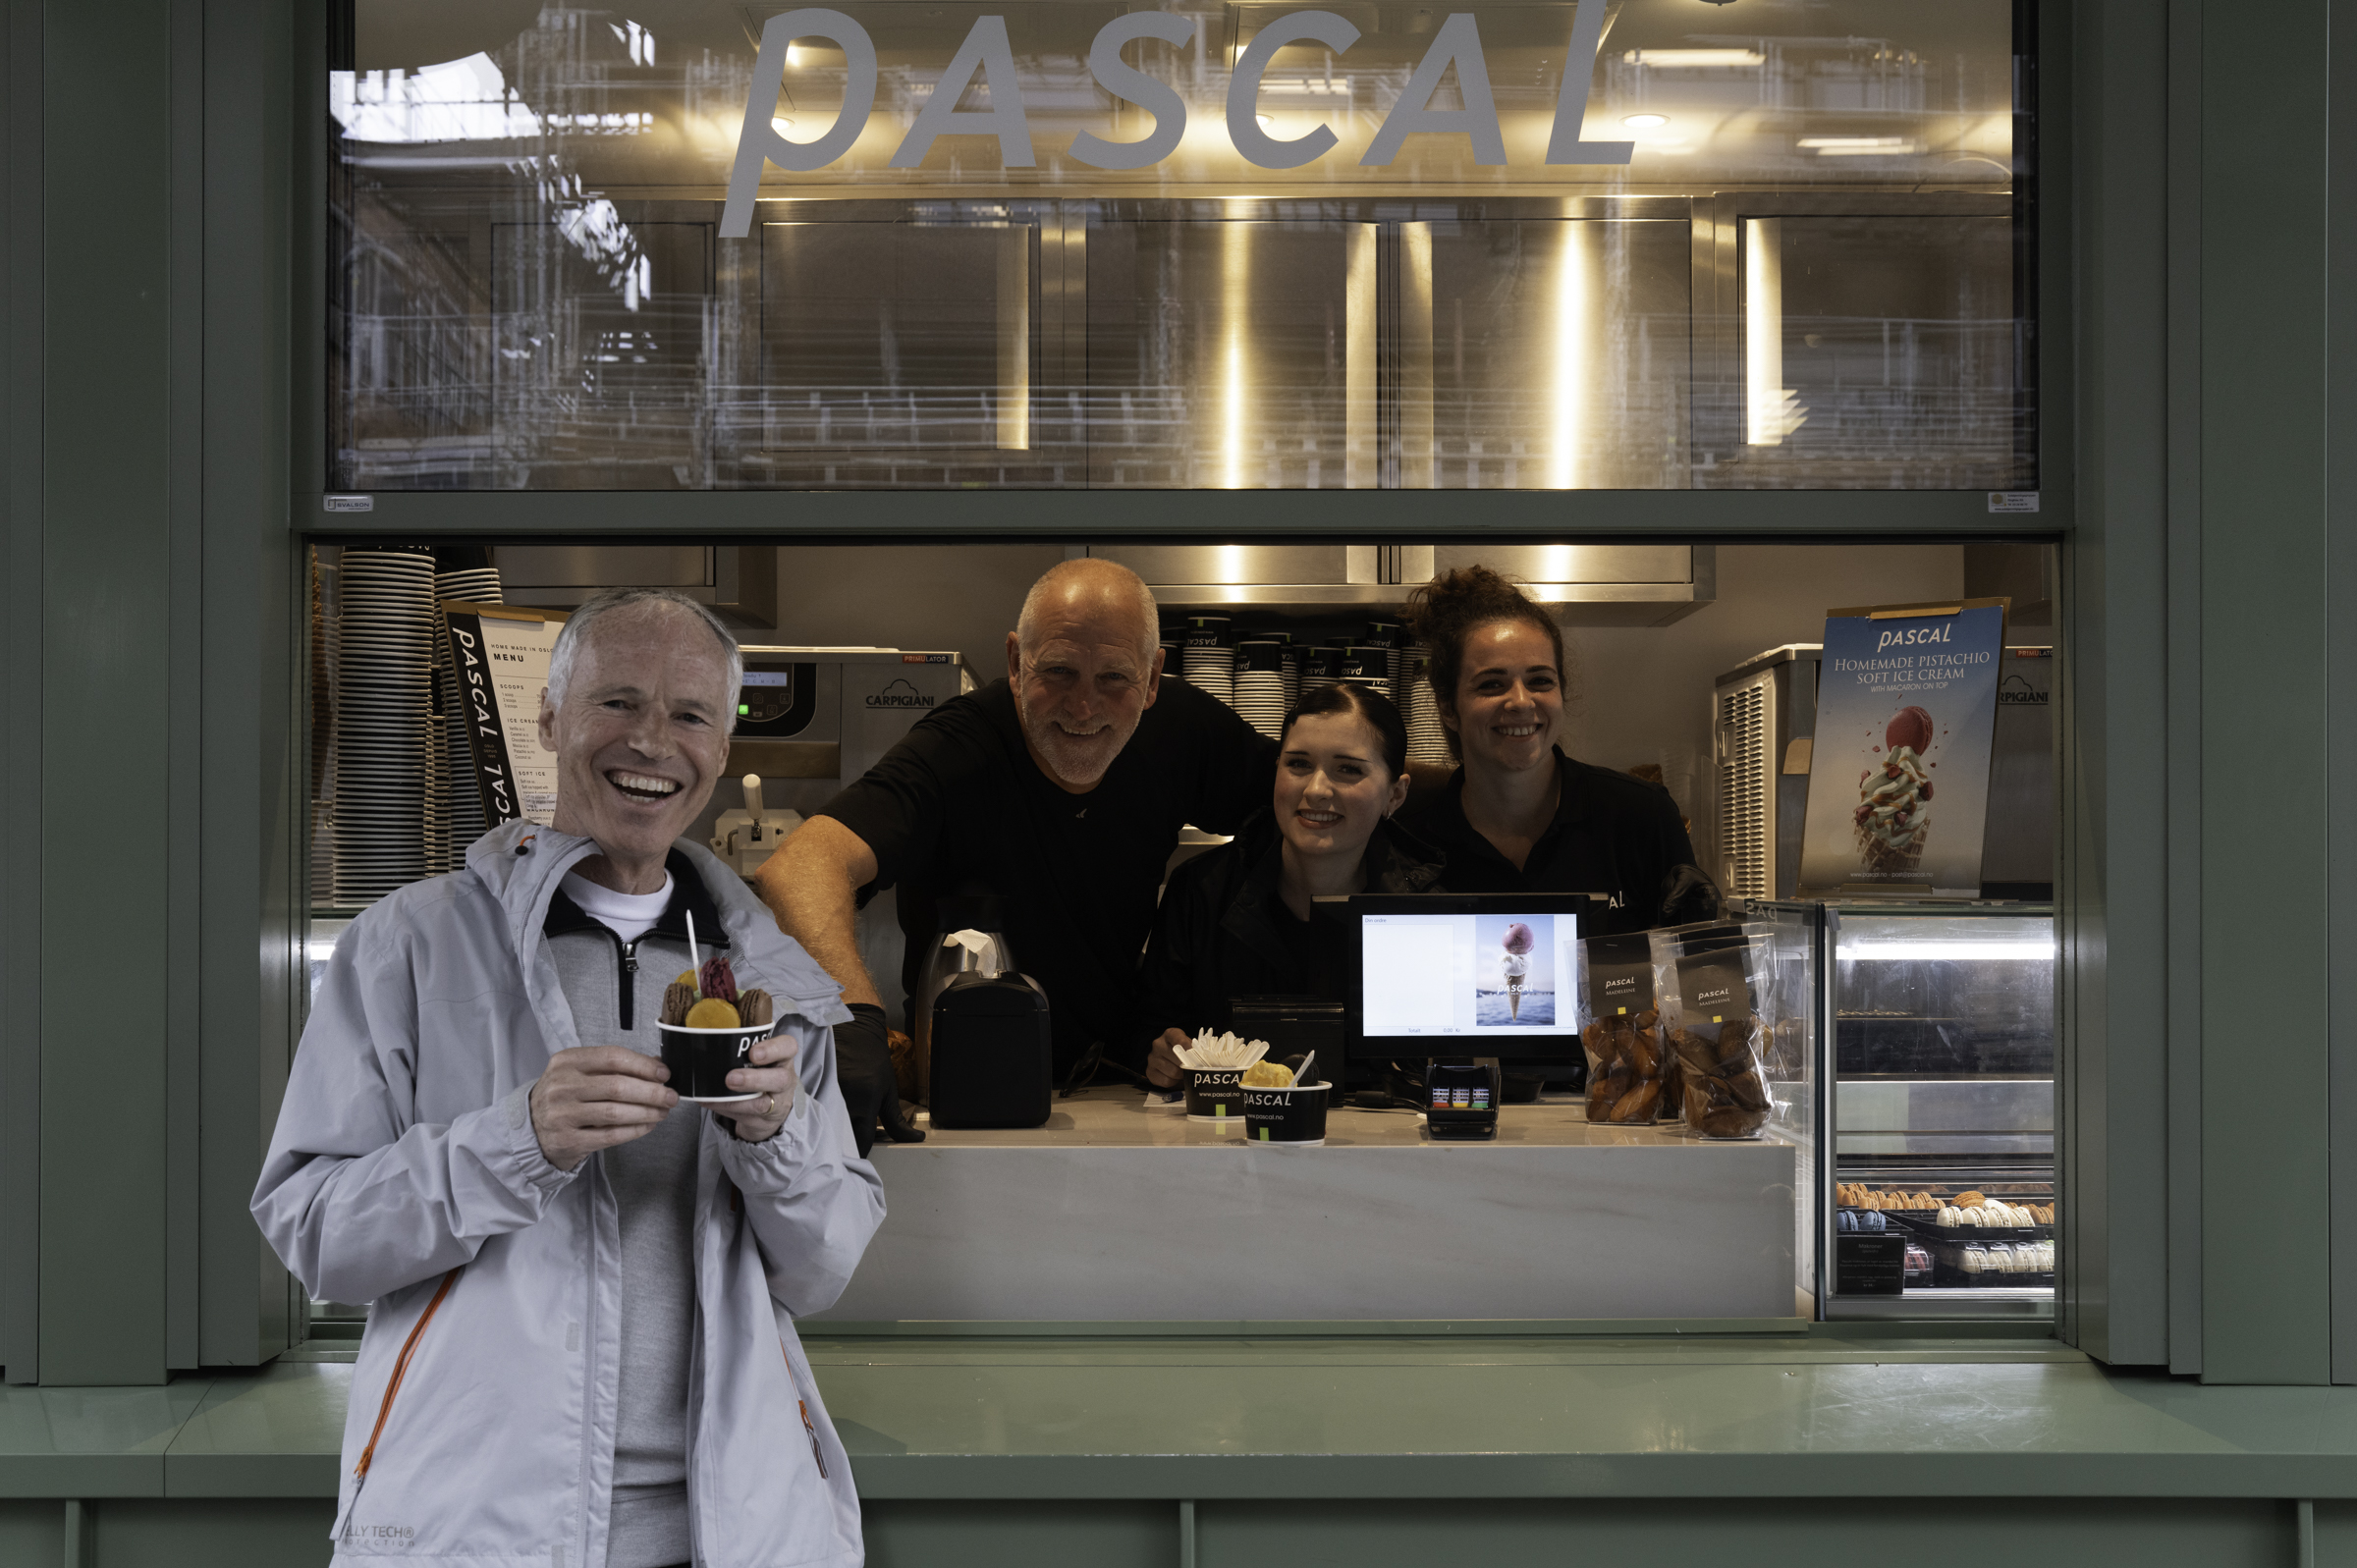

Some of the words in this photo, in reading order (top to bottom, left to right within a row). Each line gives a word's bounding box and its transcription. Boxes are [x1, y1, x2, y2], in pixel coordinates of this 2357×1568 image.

[493, 653, 524, 662] MENU
[1835, 656, 1914, 672] HOMEMADE
[1918, 651, 1991, 667] PISTACHIO
[1856, 672, 1890, 684] SOFT
[1893, 670, 1914, 682] ICE
[1918, 668, 1965, 680] CREAM
[1886, 682, 1921, 692] MACARON
[865, 695, 934, 707] CARPIGIANI
[1606, 987, 1636, 996] MADELEINE
[1193, 1071, 1246, 1088] pASCA
